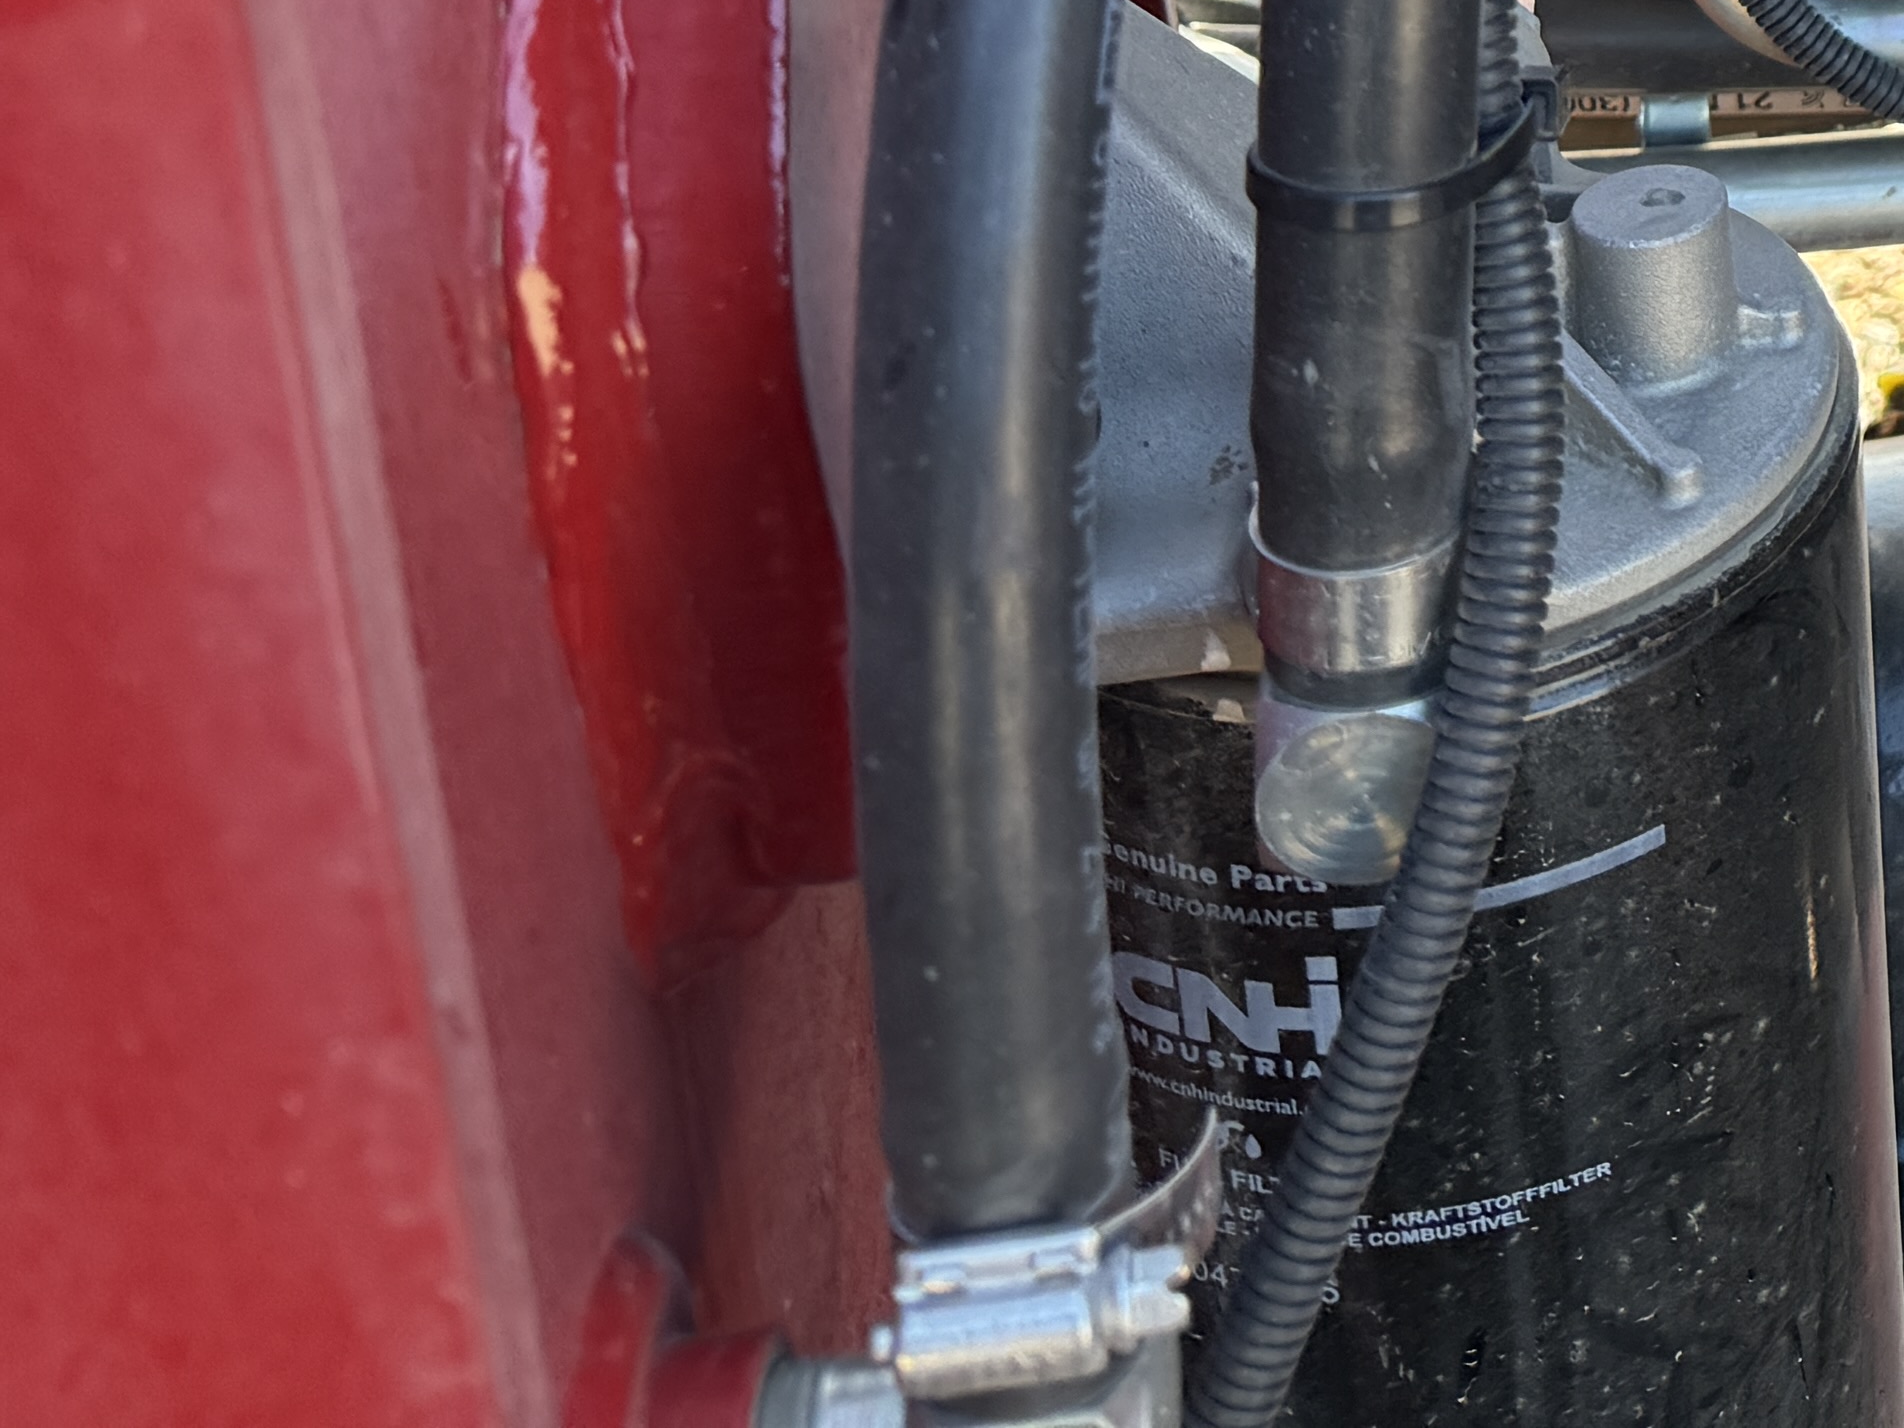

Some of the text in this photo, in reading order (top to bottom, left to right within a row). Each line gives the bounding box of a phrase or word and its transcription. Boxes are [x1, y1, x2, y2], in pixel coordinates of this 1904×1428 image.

[1133, 885, 1320, 929] PERFORMANCE
[1130, 1022, 1323, 1079] NDUSTRIA
[1130, 1064, 1309, 1118] ww.cnhindustrial.
[1391, 1161, 1612, 1228] KRAFTSTOFFFILTER
